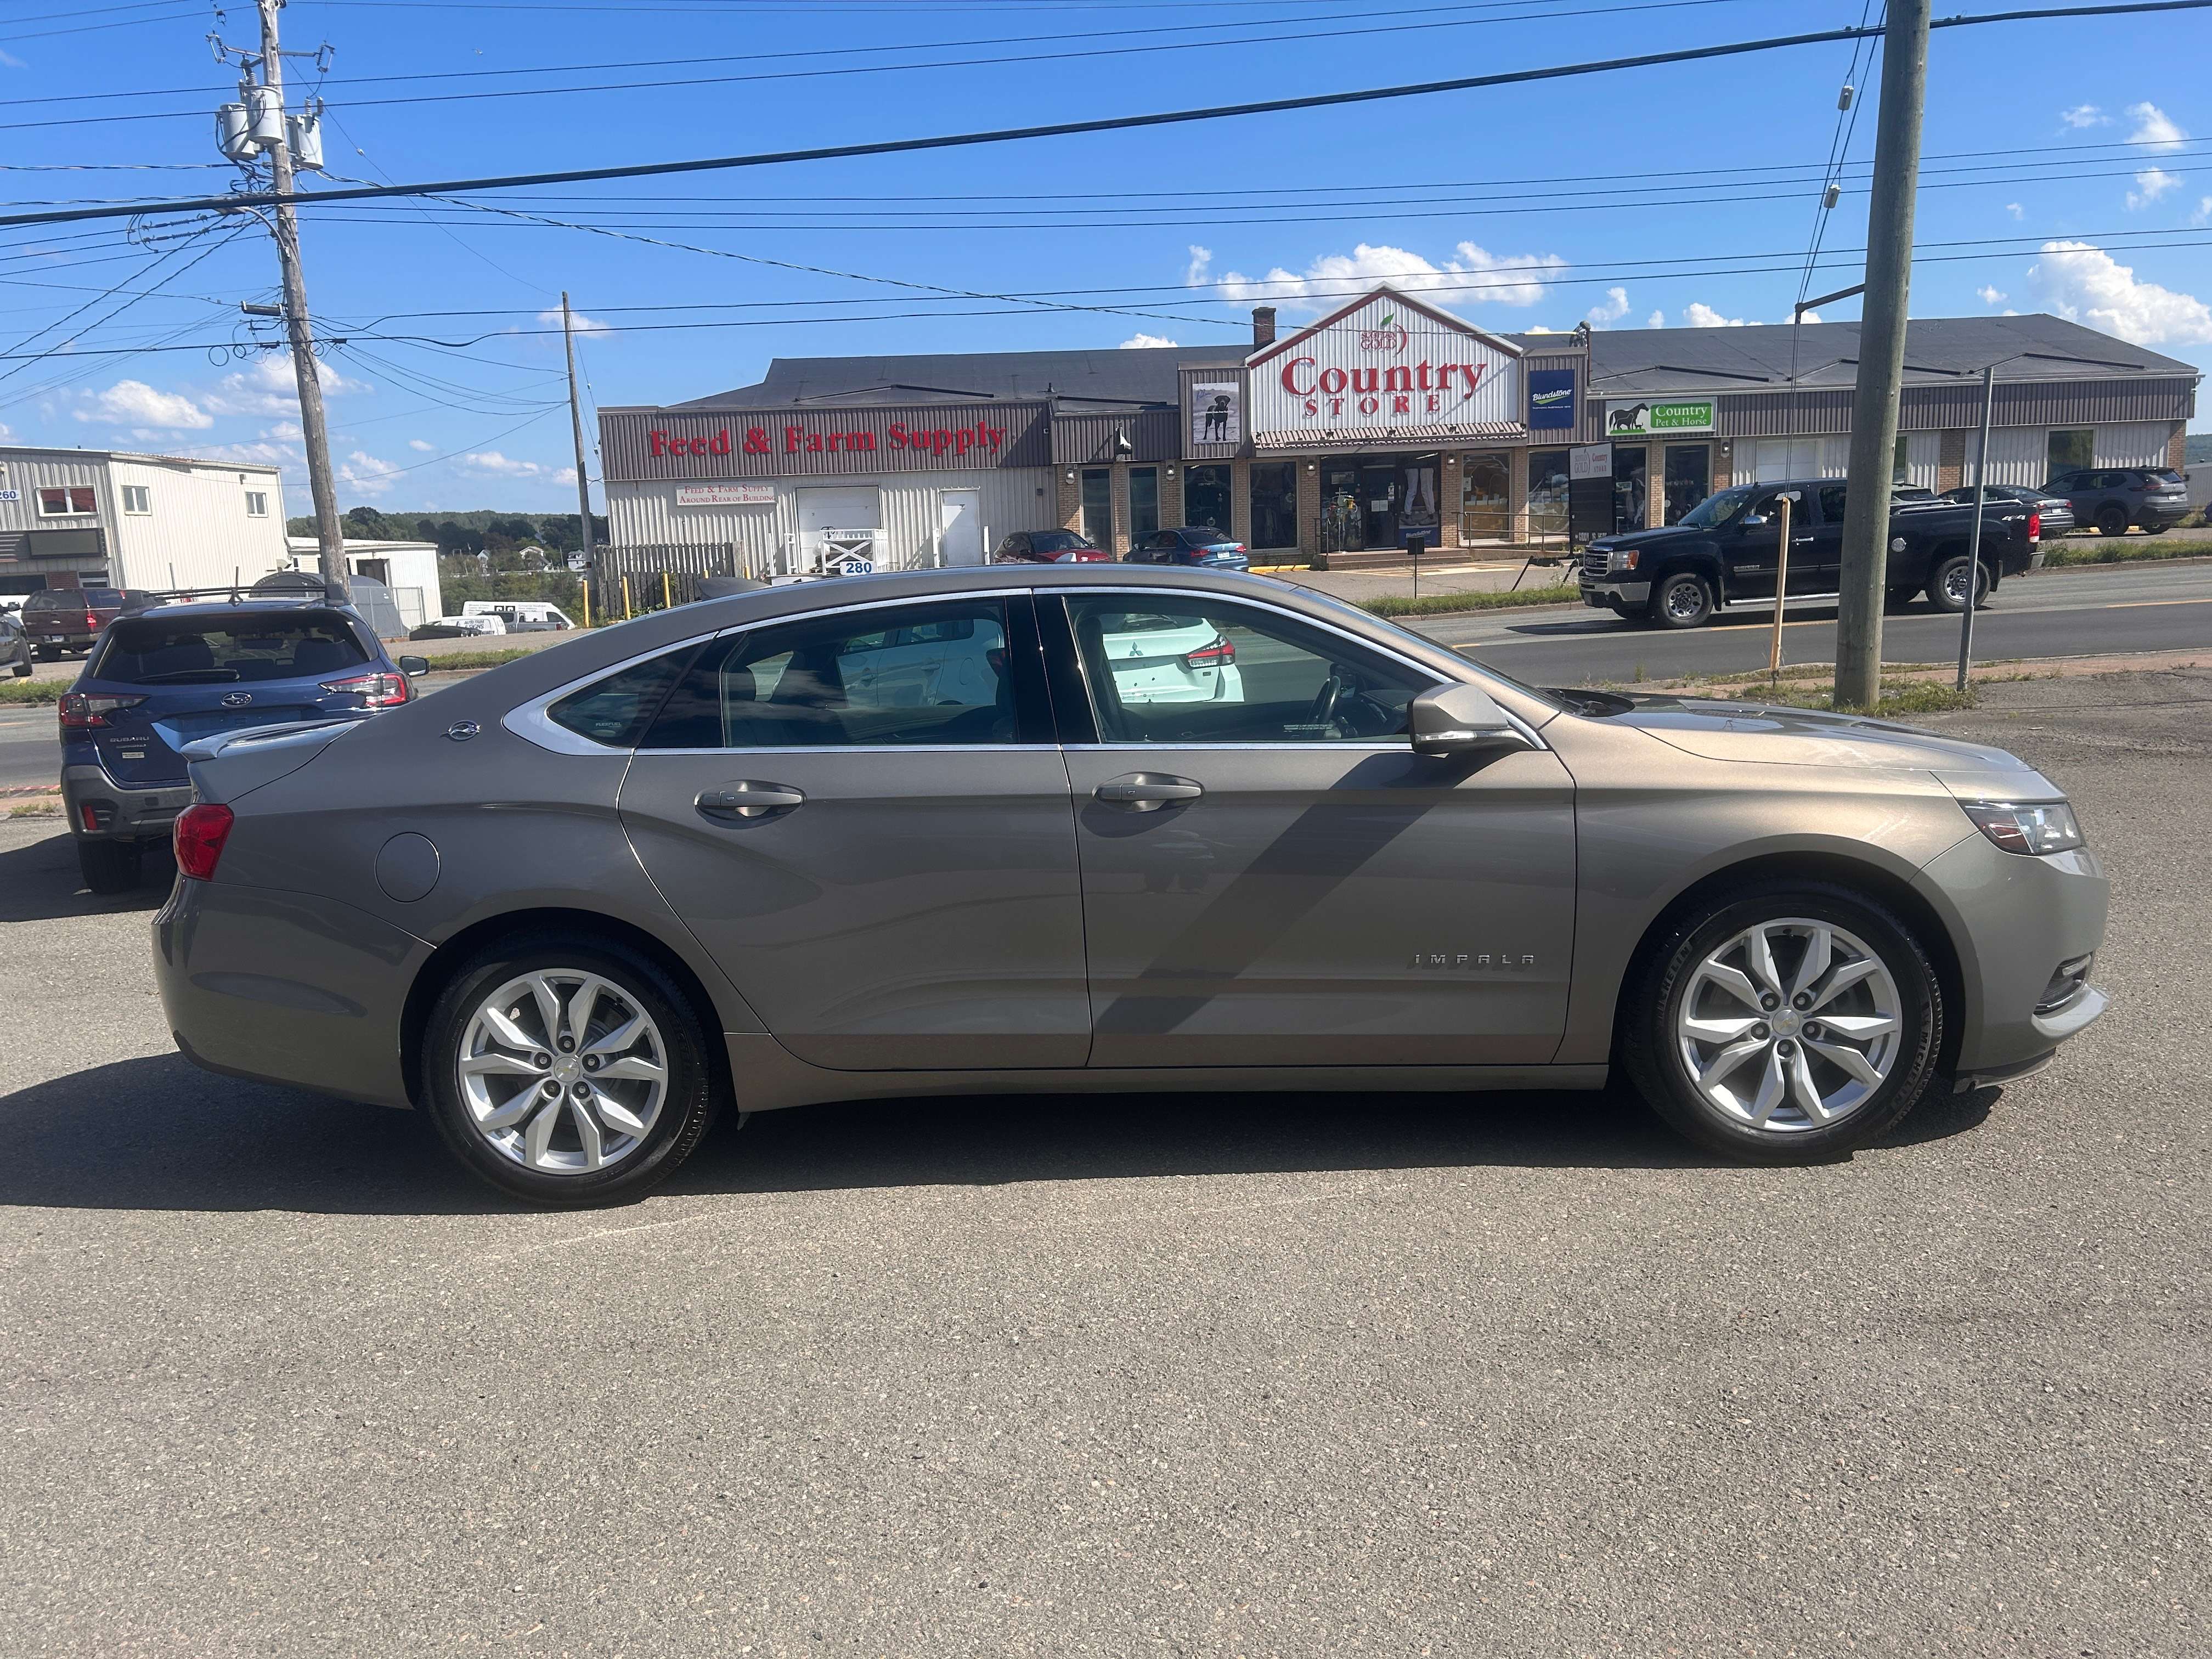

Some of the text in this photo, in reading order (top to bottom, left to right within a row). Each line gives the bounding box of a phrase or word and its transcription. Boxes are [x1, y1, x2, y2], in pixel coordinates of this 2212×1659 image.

[1361, 340, 1397, 349] GOLD
[1282, 357, 1487, 399] Country
[1532, 389, 1572, 401] Blundstone
[1305, 394, 1440, 416] STORE
[1656, 405, 1707, 418] Country
[650, 420, 1007, 456] Feed & Farm Supply
[742, 484, 769, 492] SUPPLY
[680, 495, 711, 504] AROUND
[845, 562, 872, 573] 280
[1415, 954, 1534, 964] IMPALA
